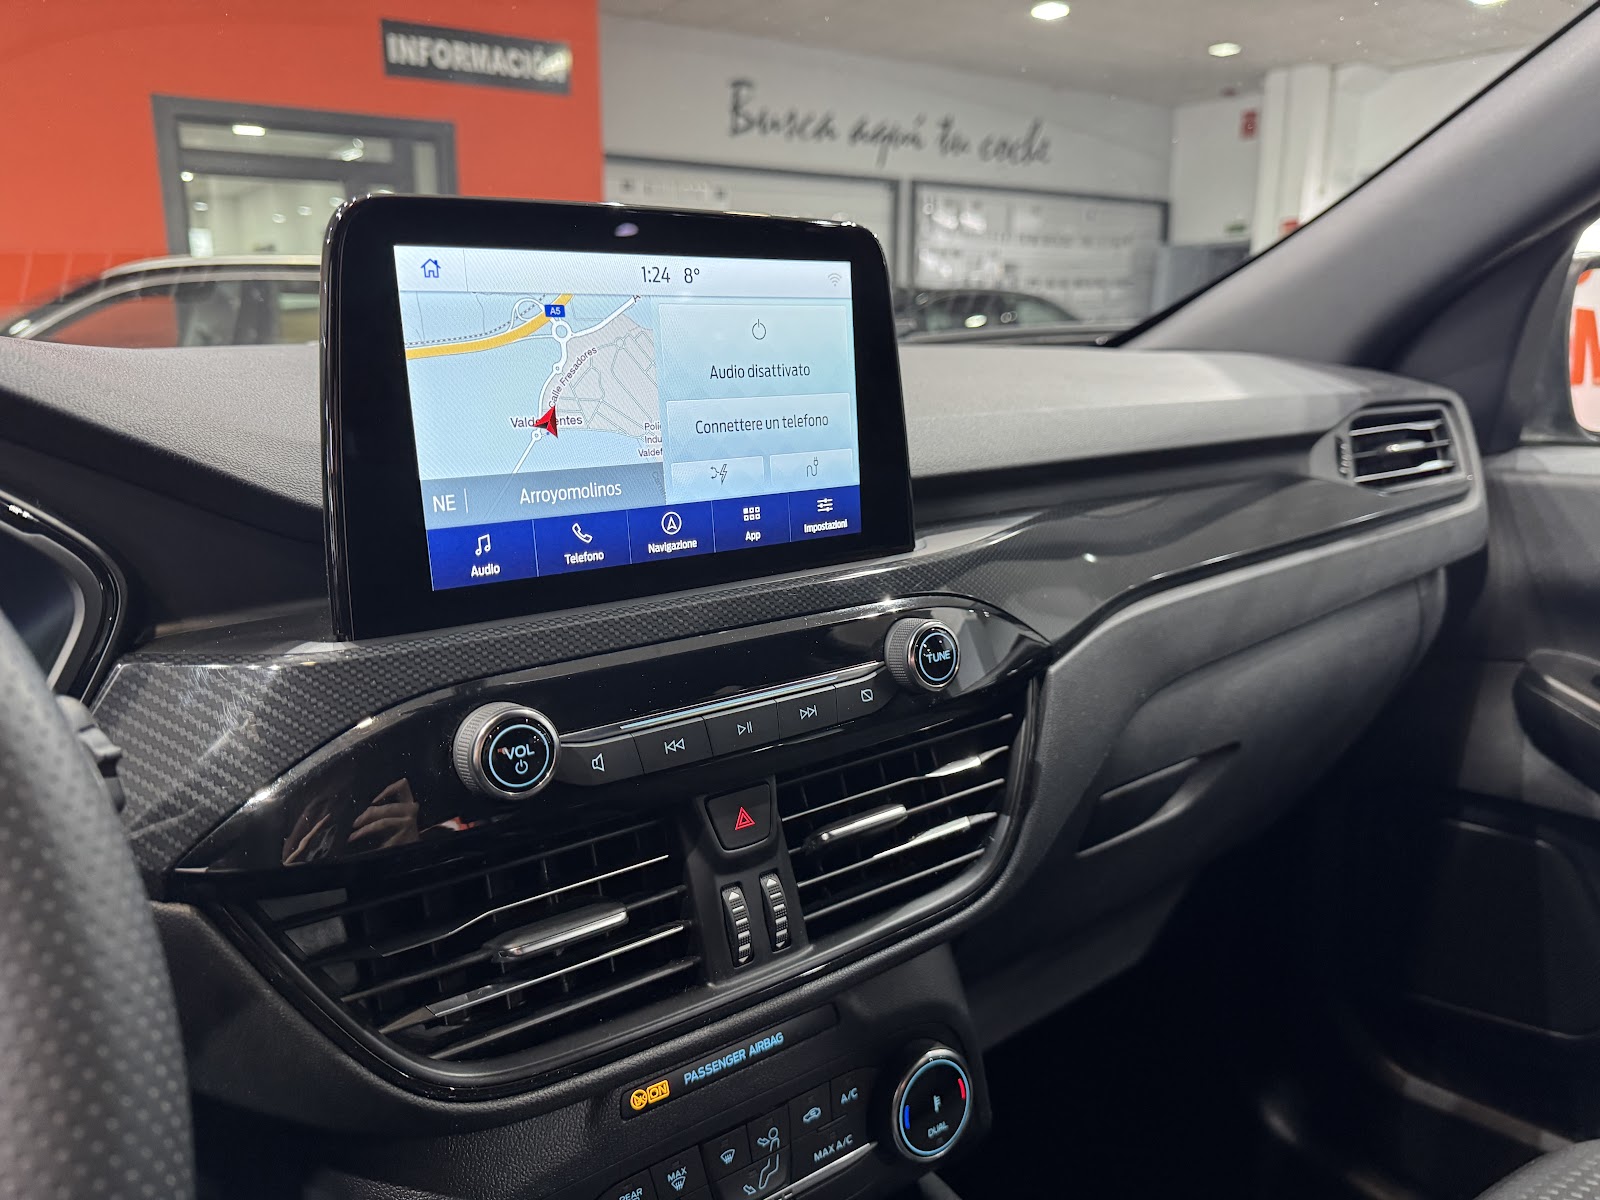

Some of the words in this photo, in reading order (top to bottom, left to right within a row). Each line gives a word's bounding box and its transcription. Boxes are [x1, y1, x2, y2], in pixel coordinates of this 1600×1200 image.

[641, 266, 671, 283] 1:24
[549, 306, 562, 316] A5
[548, 385, 563, 408] Calle
[559, 347, 598, 386] Fresadores
[710, 365, 745, 380] Audio
[747, 363, 811, 379] disattivato
[510, 415, 583, 428] Valdentes
[695, 420, 763, 435] Connettere
[765, 419, 780, 430] un
[782, 414, 829, 429] telefono
[520, 482, 622, 505] Arroyomolinos
[433, 494, 456, 512] NE
[804, 519, 848, 534] Impostazioni
[745, 531, 761, 542] App
[648, 539, 698, 554] Navigazione
[564, 551, 604, 565] Telefono
[471, 564, 500, 578] Audio
[926, 650, 951, 664] TUNE
[503, 743, 536, 760] VOL
[683, 1049, 747, 1086] PASSENGER
[748, 1031, 784, 1057] AIRBAG
[649, 1083, 667, 1099] ON
[840, 1087, 859, 1105] A/C
[927, 1121, 949, 1138] DUAL
[813, 1142, 836, 1162] MAX
[835, 1134, 854, 1149] A/C
[667, 1166, 688, 1182] MAX
